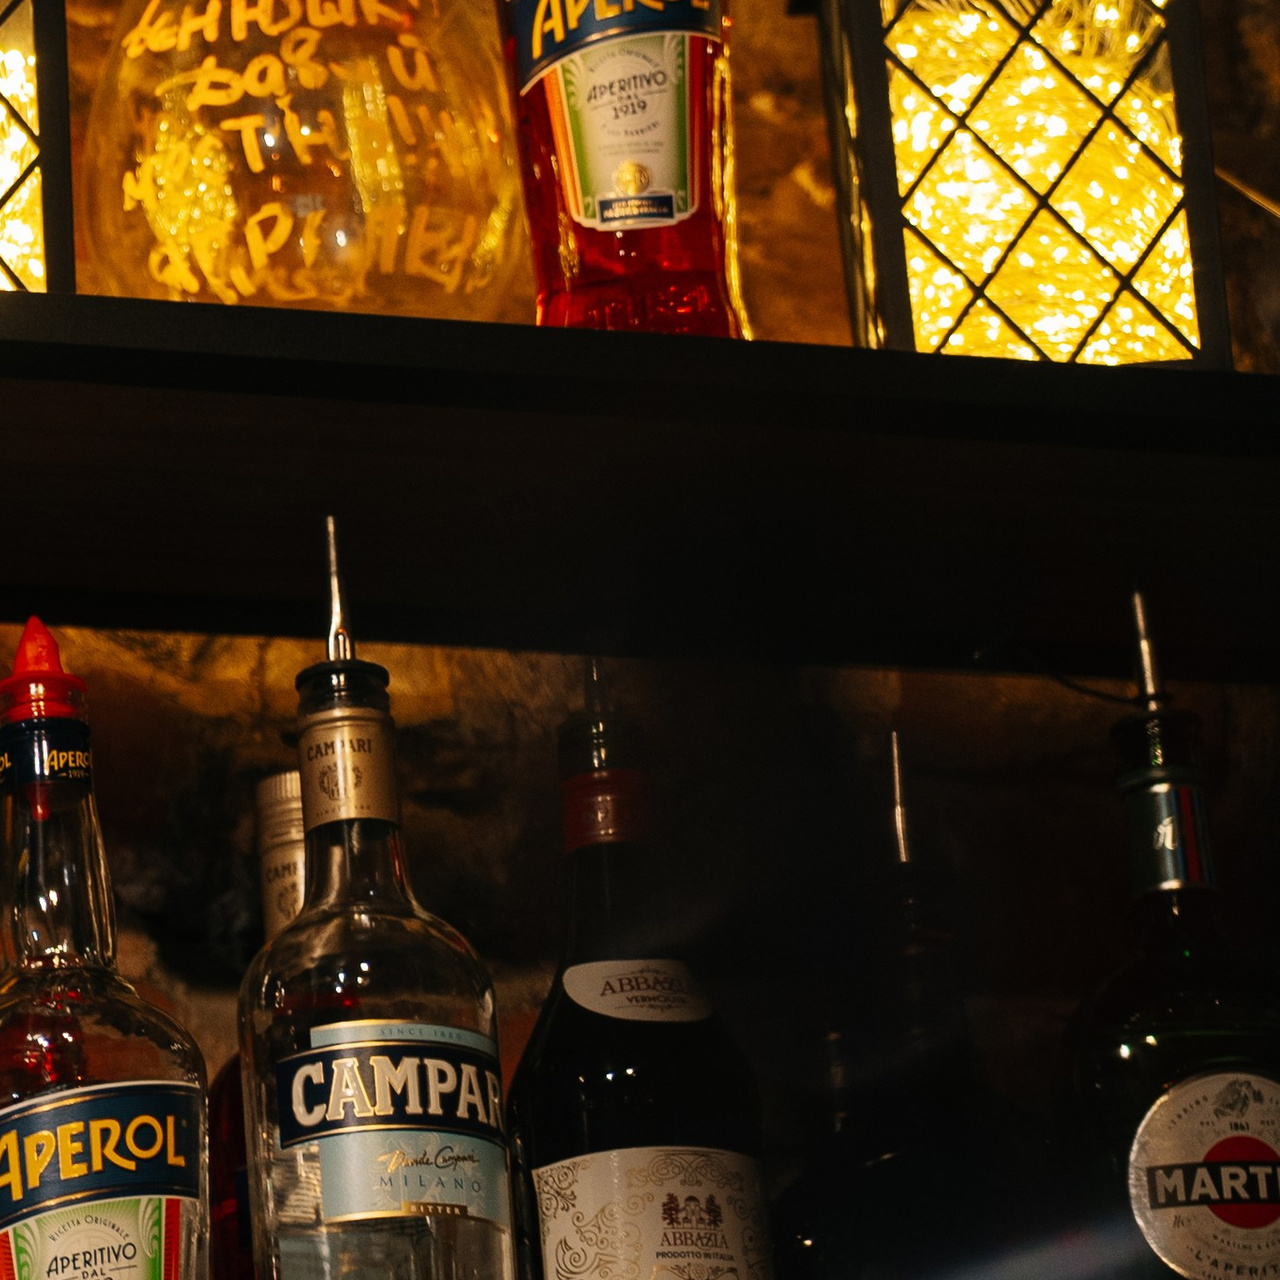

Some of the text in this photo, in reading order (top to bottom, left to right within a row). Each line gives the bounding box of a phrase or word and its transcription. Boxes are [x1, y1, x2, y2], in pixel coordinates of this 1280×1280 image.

[586, 69, 668, 103] APERITIVO
[306, 737, 372, 762] CAMARI
[379, 1028, 423, 1038] SINCE
[379, 1175, 481, 1194] MILANO
[1153, 1165, 1280, 1205] MART
[410, 1203, 462, 1216] BITTER
[48, 1214, 131, 1243] RICETTA ORIGINALE
[660, 1230, 729, 1250] ABBAZIA
[46, 1242, 137, 1279] APERITIVO
[655, 1250, 702, 1260] PRODOTTO
[81, 1267, 106, 1280] DAL
